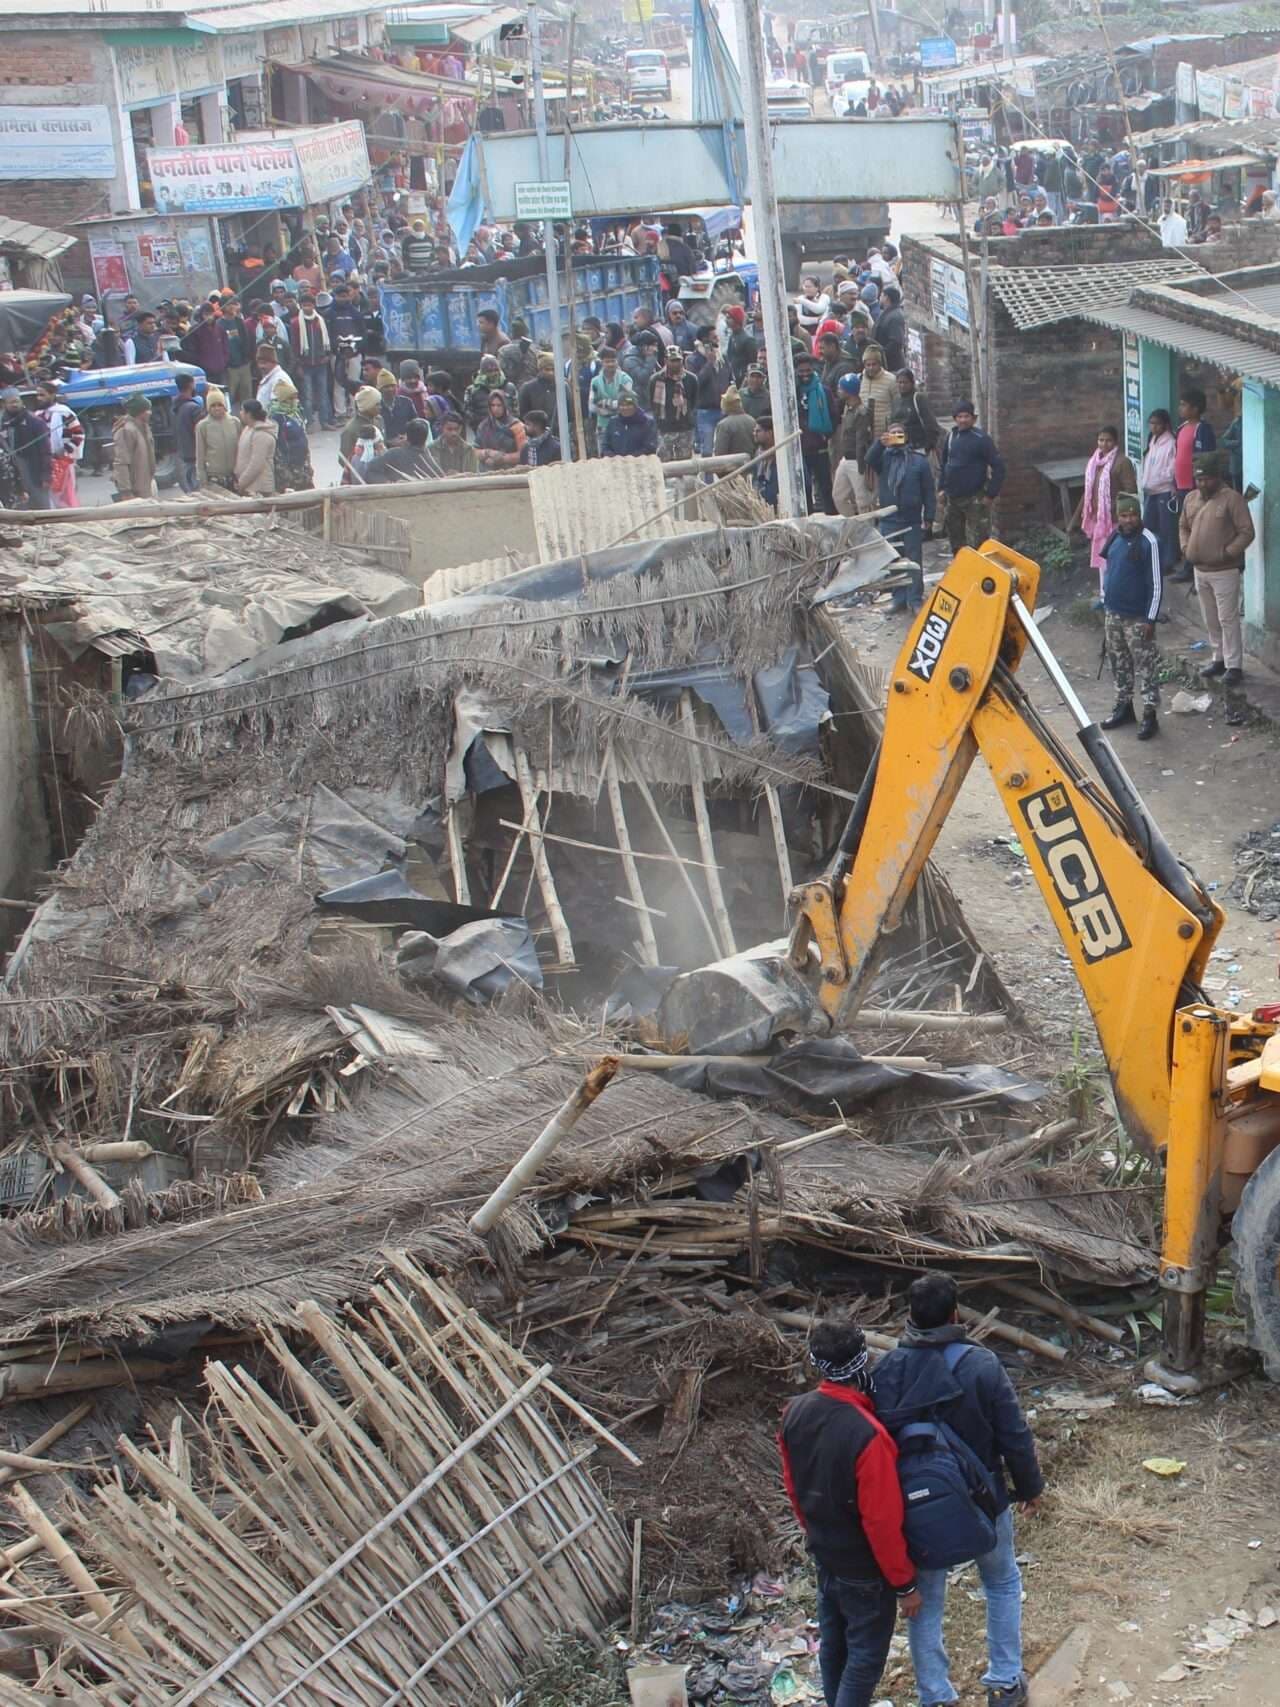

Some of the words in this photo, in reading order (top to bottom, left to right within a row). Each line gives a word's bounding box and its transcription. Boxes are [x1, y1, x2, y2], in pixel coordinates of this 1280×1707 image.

[214, 153, 247, 174] पान
[908, 614, 948, 679] 3DX
[1026, 798, 1123, 959] JCB
